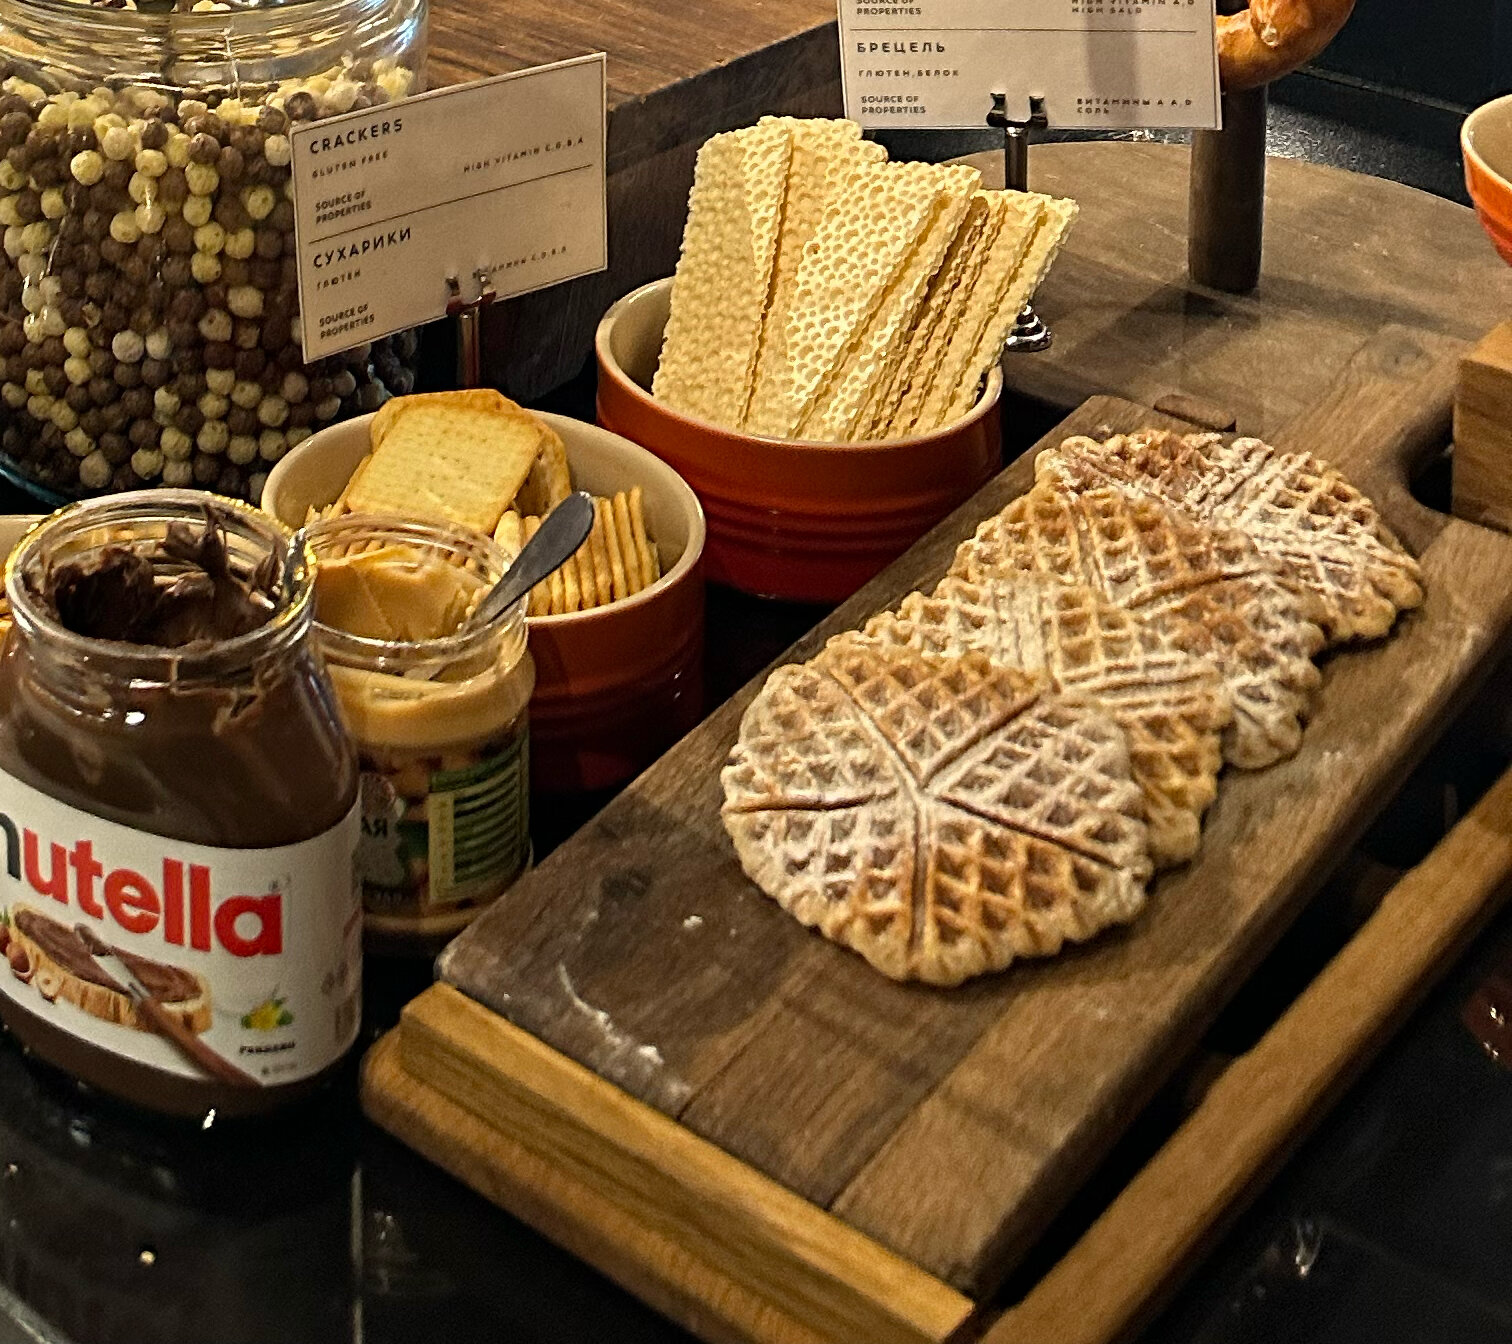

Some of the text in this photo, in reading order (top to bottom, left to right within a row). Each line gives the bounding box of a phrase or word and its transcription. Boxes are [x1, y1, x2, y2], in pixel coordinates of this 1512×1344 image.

[856, 7, 922, 16] PROPERTIES
[857, 42, 946, 54] БРЕЦЕЛЬ
[860, 95, 919, 104] SOURCE OF
[861, 105, 927, 114] PROPERTIES
[309, 118, 403, 154] CRACKERS
[312, 150, 389, 179] GLUTEN FREE
[315, 189, 366, 212] SOURCE OF
[316, 200, 372, 225] PROPERTIES
[313, 227, 411, 269] СУХАРИКИ
[319, 303, 368, 327] SOURCE OF
[320, 313, 375, 340] PROPERTIES
